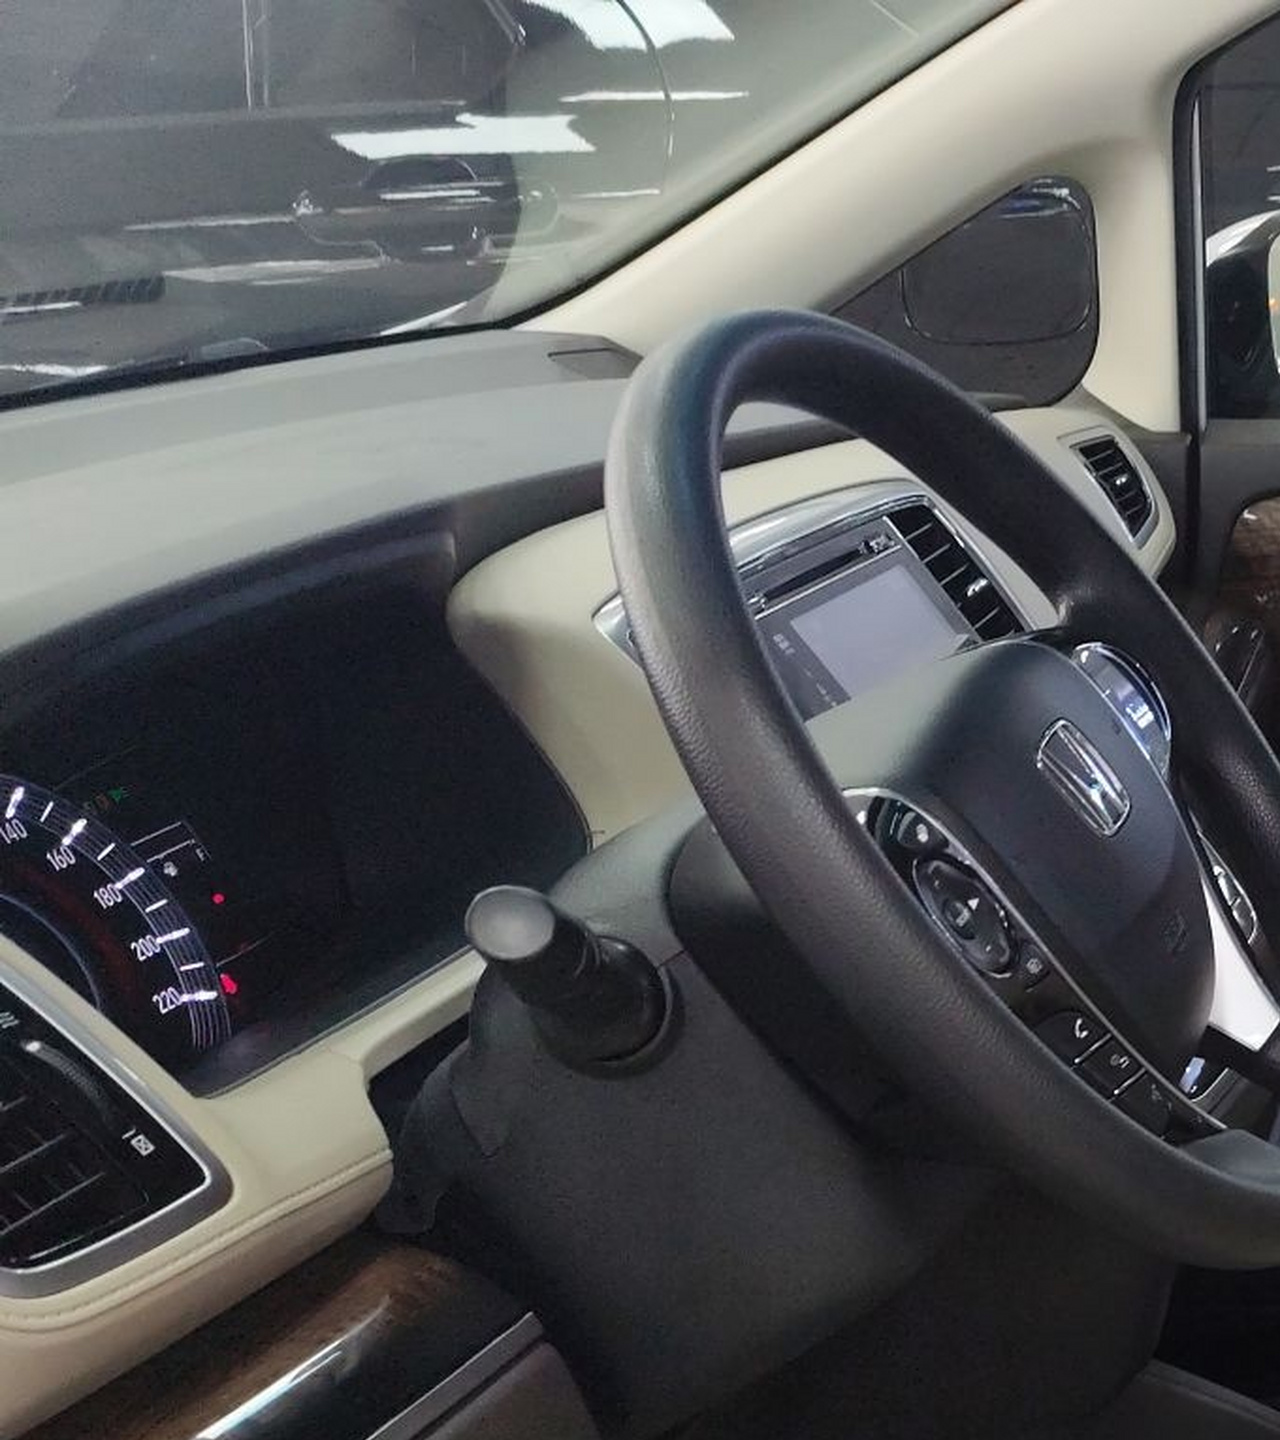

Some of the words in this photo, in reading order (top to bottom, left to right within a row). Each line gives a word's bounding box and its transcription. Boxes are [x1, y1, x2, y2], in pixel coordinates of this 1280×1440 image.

[0, 818, 28, 844] 140
[46, 845, 76, 872] 160
[93, 883, 123, 909] 180
[130, 934, 162, 961] 200
[152, 986, 184, 1014] 220
